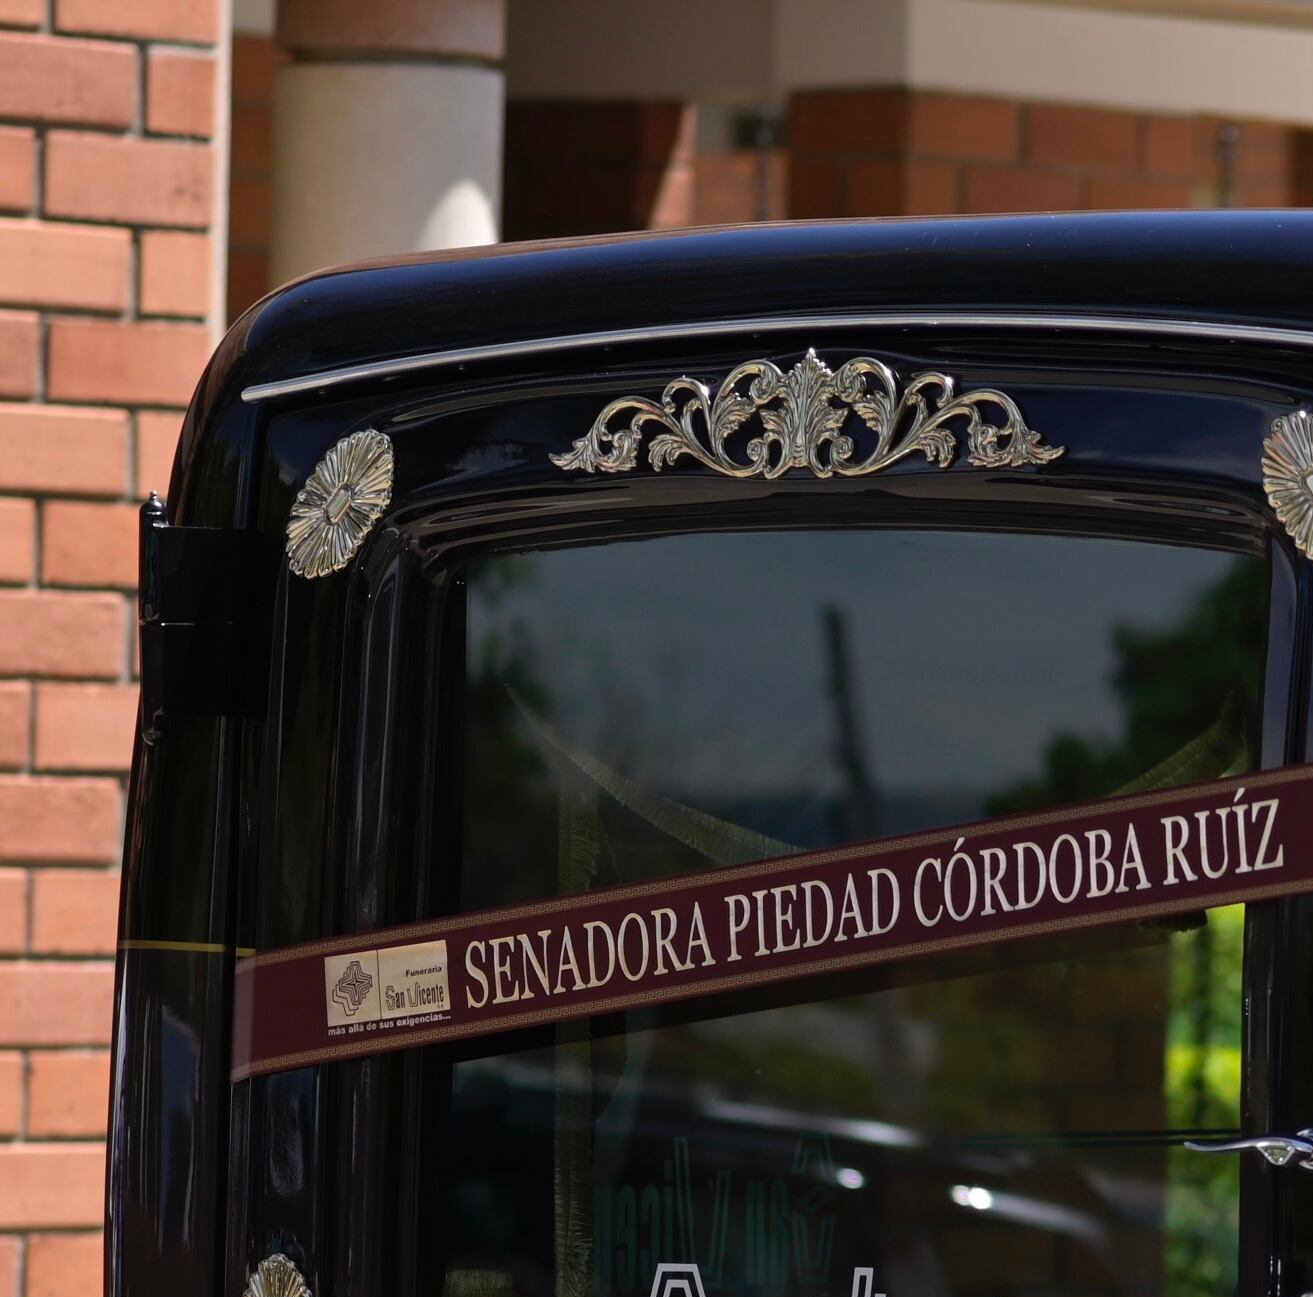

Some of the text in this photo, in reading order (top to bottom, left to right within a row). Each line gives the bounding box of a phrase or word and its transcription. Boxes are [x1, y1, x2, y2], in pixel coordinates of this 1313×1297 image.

[465, 787, 1284, 1009] SENADORA PIEDAD CÓRDOBA RUÍZ
[405, 966, 442, 977] Funeraria
[386, 982, 444, 1010] San Vicente
[328, 1026, 346, 1036] más
[348, 1024, 365, 1034] allá
[366, 1021, 377, 1031] de
[379, 1019, 394, 1028] sus
